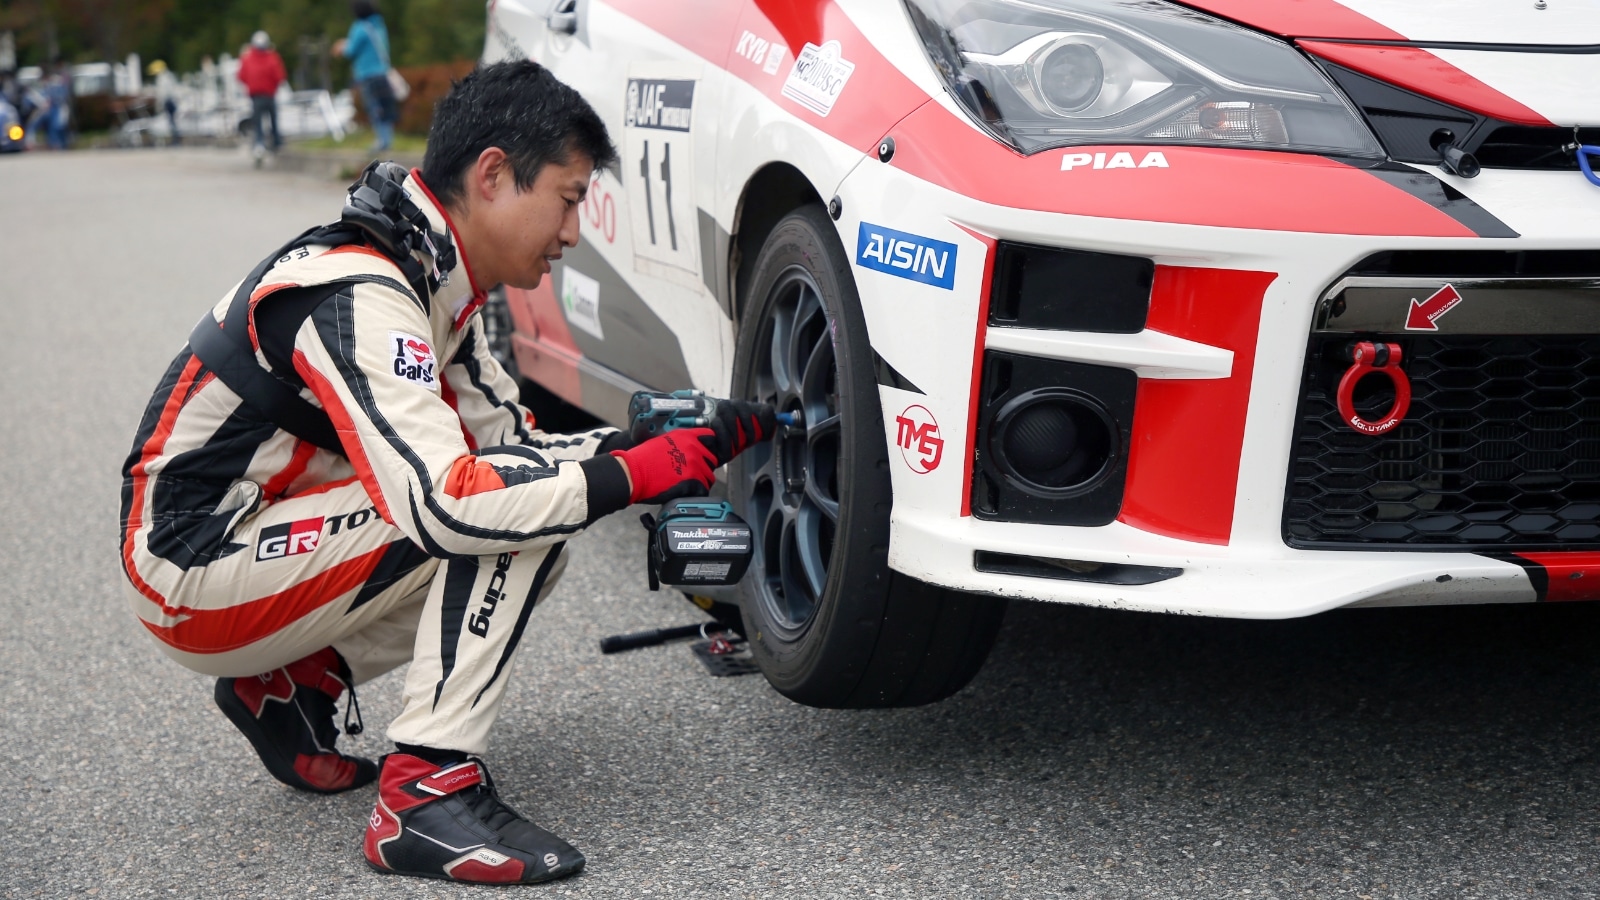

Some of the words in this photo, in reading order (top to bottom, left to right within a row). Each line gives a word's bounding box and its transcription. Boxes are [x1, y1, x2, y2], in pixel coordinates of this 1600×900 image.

[637, 84, 666, 126] JAF
[1060, 151, 1170, 171] PIAA
[640, 140, 678, 251] 11
[862, 233, 949, 279] AISIN
[396, 338, 405, 357] I
[394, 358, 434, 383] Cars!
[259, 530, 319, 559] GR
